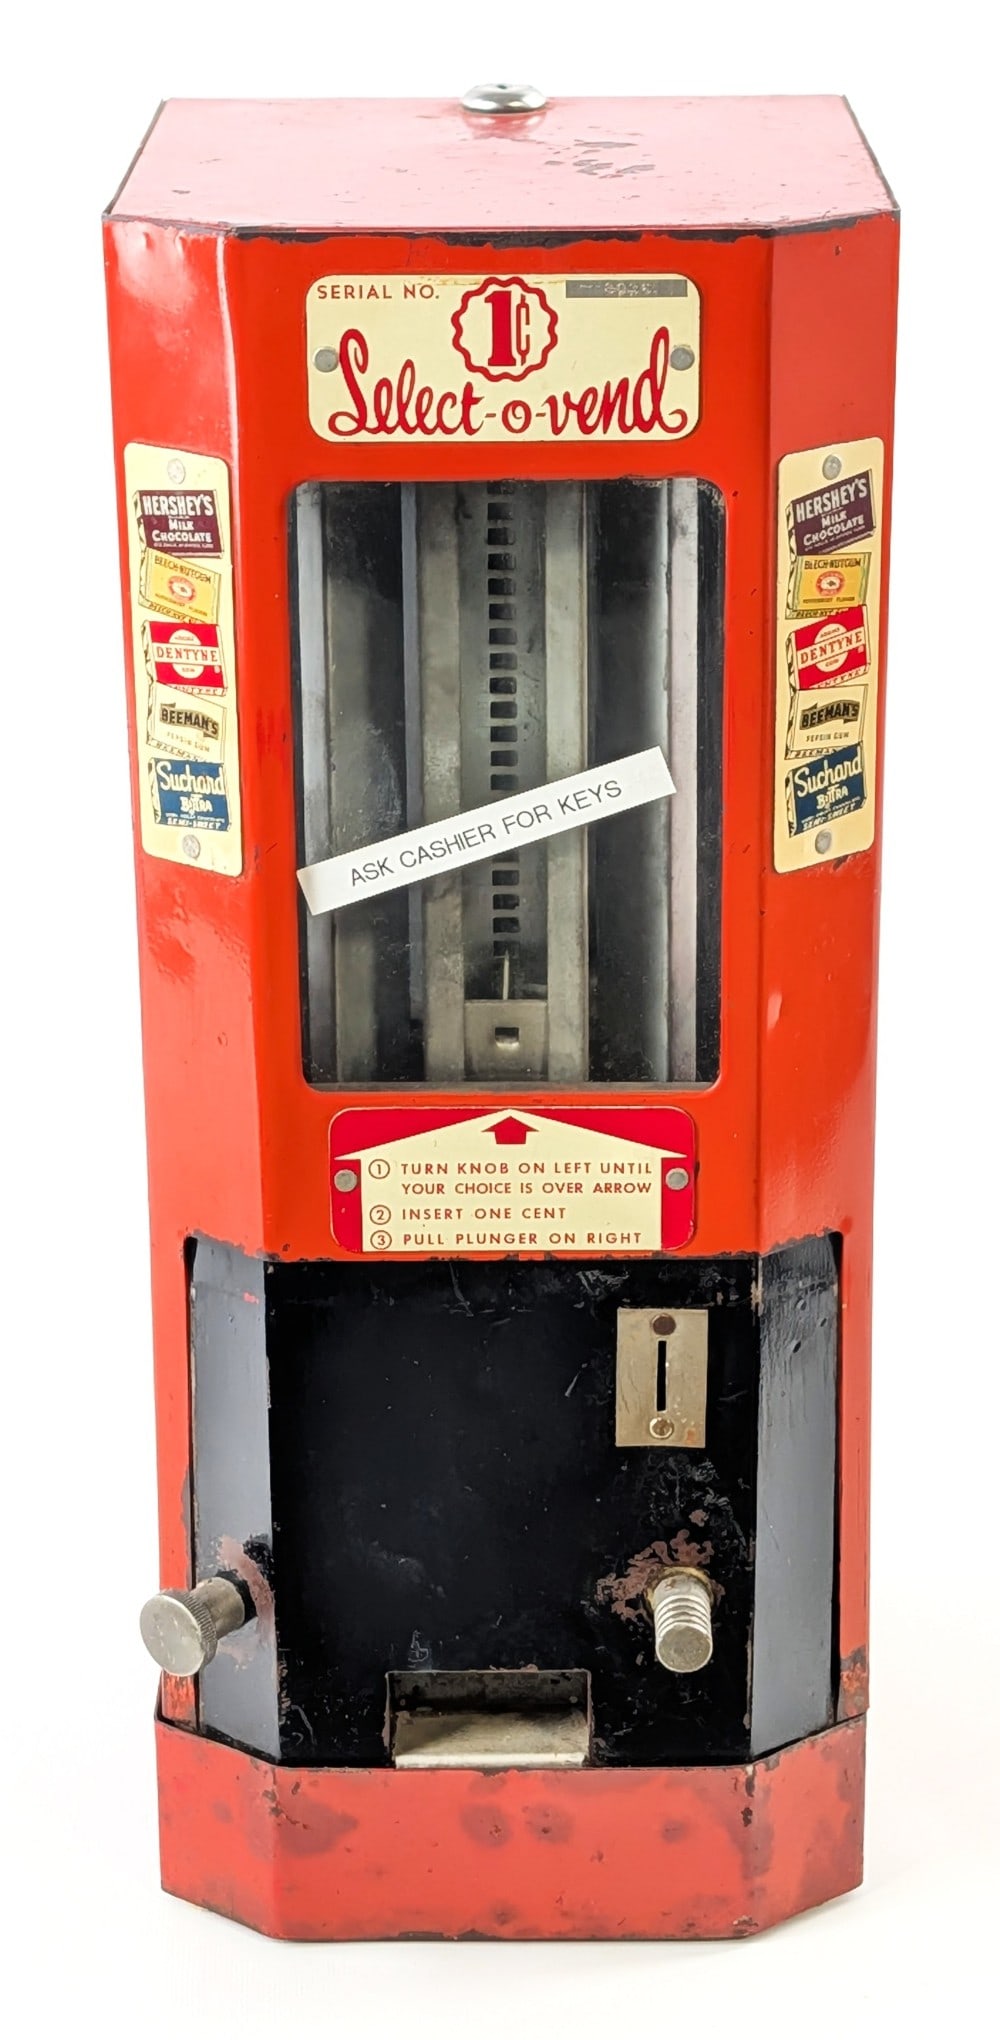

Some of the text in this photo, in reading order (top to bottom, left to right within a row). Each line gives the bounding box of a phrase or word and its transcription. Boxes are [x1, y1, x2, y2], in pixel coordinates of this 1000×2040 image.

[317, 284, 440, 300] SERIAL NO.
[328, 325, 688, 436] Select-o-vend
[142, 494, 215, 517] HERSHEY'S
[796, 478, 868, 524] HERSHEY'S
[151, 529, 213, 543] CHOCOLATE
[803, 514, 865, 546] CHOCOLATE
[156, 646, 218, 663] DENTYNE
[800, 630, 863, 665] DENTYNE
[161, 707, 219, 735] BEEMAN'S
[801, 702, 860, 728] BEEMAN'S
[156, 760, 226, 796] Suchard
[794, 745, 863, 798] Suchard
[350, 780, 622, 887] ASK CASHIER FOR KEYS
[401, 1162, 448, 1175] TURN
[457, 1162, 509, 1175] KNOB
[518, 1162, 545, 1175] ON
[554, 1162, 591, 1175] LEFT
[600, 1162, 652, 1175] UNTIL
[402, 1182, 652, 1194] YOUR CHOICE IS OVER ARROW
[402, 1208, 463, 1220] INSERT
[474, 1208, 512, 1220] ONE
[522, 1207, 566, 1220] CENT
[403, 1232, 445, 1245] PULL
[456, 1232, 538, 1245] PLUNGER
[549, 1232, 576, 1245] ON
[587, 1232, 642, 1245] RIGHT
